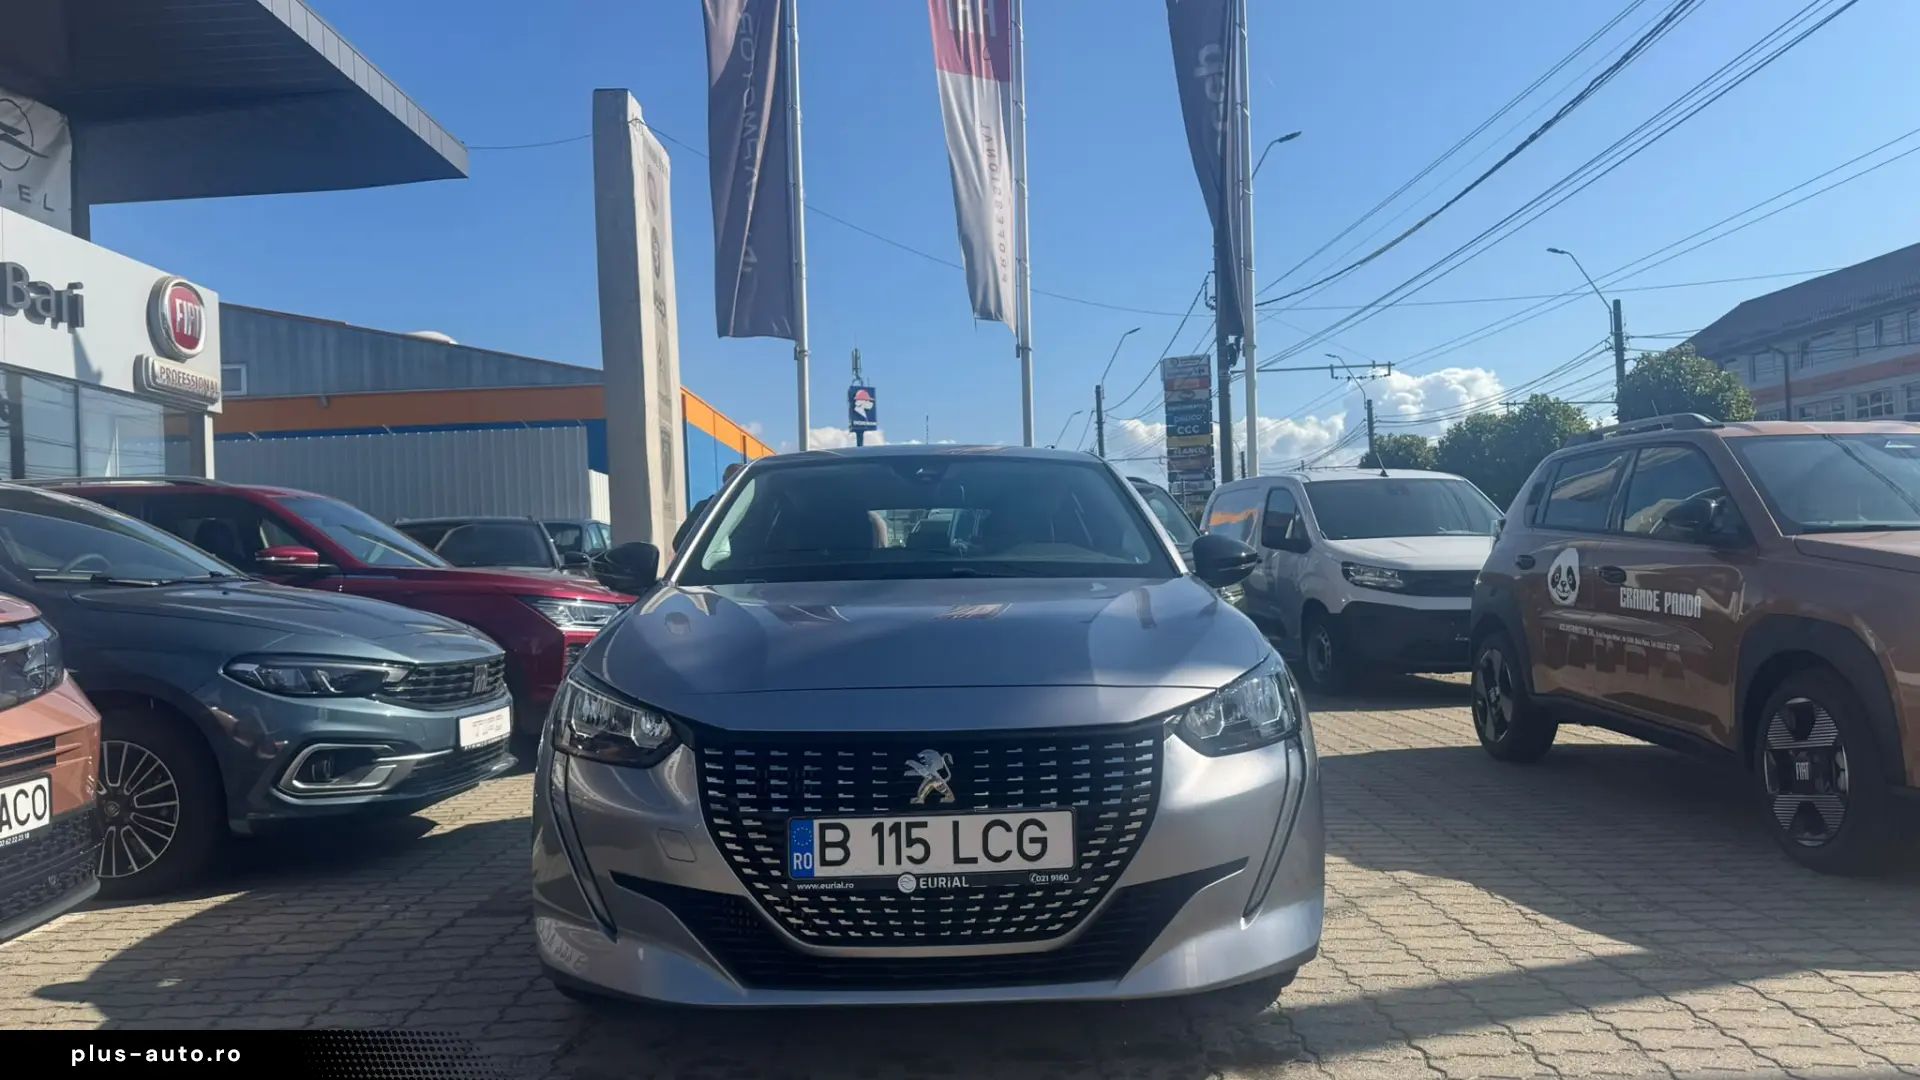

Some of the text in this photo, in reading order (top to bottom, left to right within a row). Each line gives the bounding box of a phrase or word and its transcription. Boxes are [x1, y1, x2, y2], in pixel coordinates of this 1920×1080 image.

[0, 178, 56, 212] EL
[0, 261, 84, 334] Bari
[175, 298, 201, 339] FIAT
[159, 365, 218, 393] PROFESSIONAL
[1177, 425, 1200, 435] CCC
[1620, 586, 1701, 618] GRANDE PANDA
[1795, 762, 1810, 781] FIAT
[818, 818, 1048, 867] B 115 LCG
[793, 852, 813, 870] RO
[796, 881, 855, 891] www.eurial.ro
[1050, 873, 1069, 881] 9160
